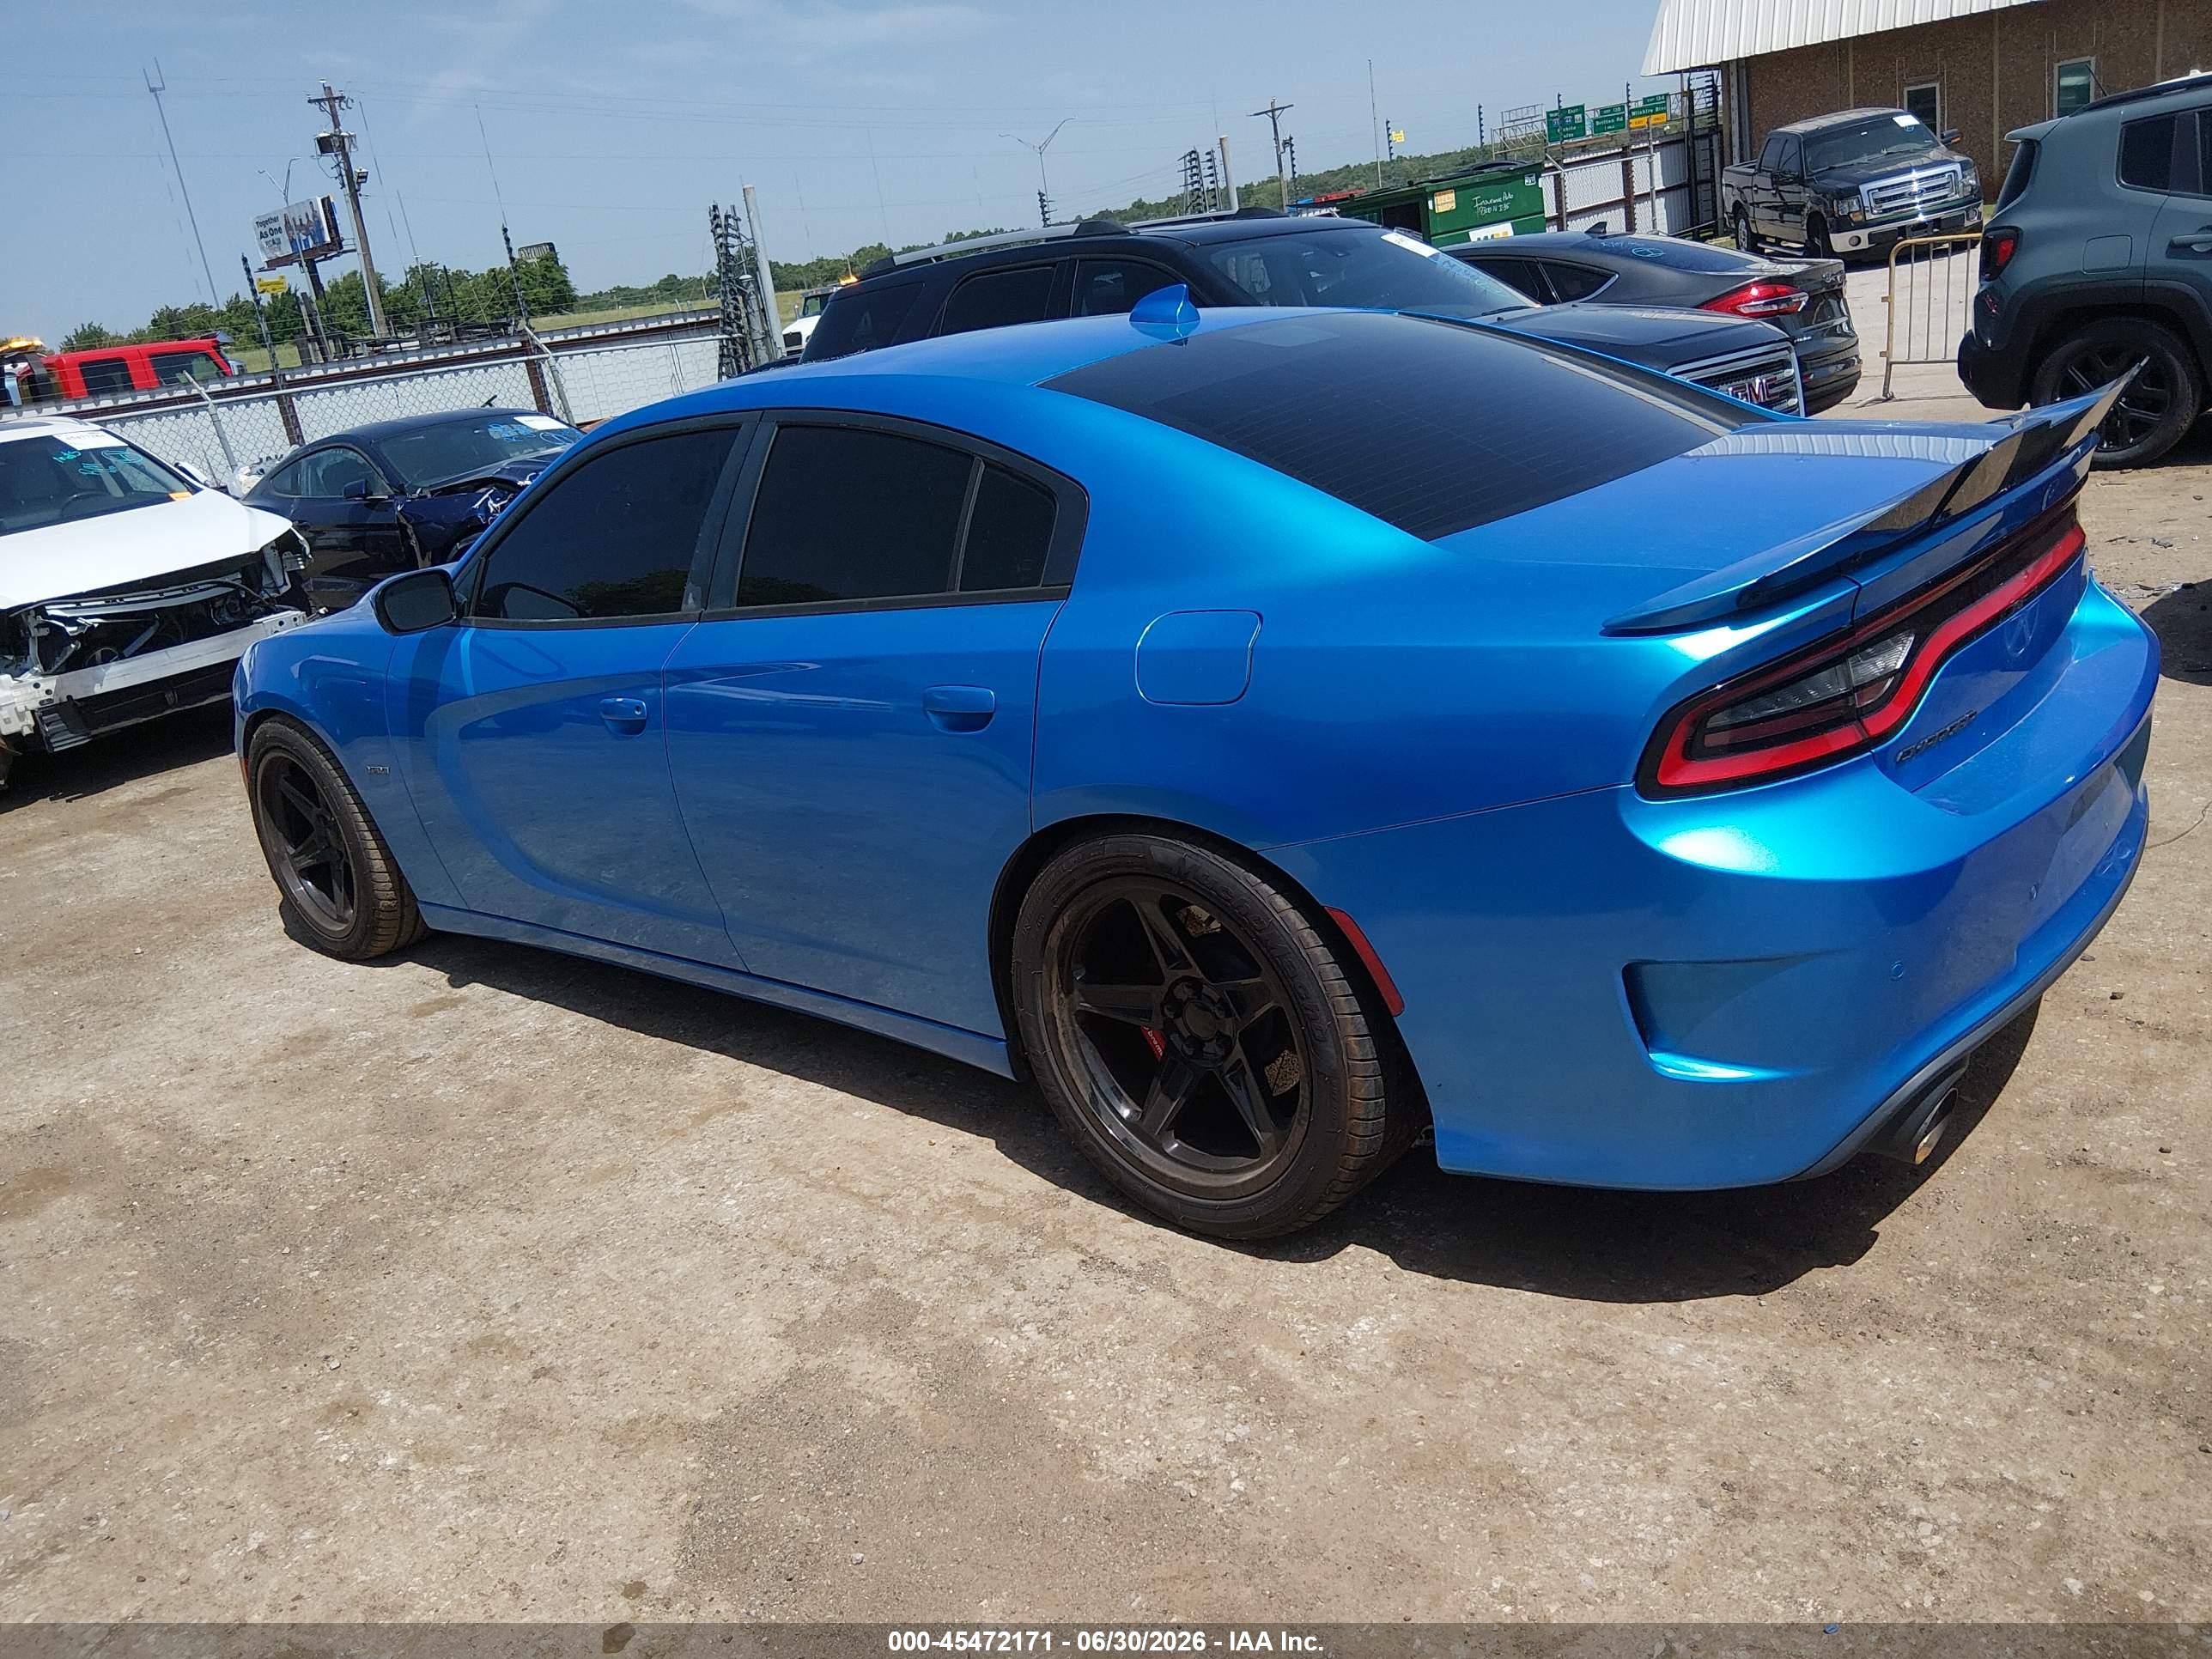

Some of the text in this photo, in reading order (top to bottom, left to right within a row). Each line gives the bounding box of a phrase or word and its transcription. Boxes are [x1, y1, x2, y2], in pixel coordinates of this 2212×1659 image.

[255, 216, 280, 228] Together
[259, 226, 283, 240] As One
[1728, 375, 1780, 404] GMC
